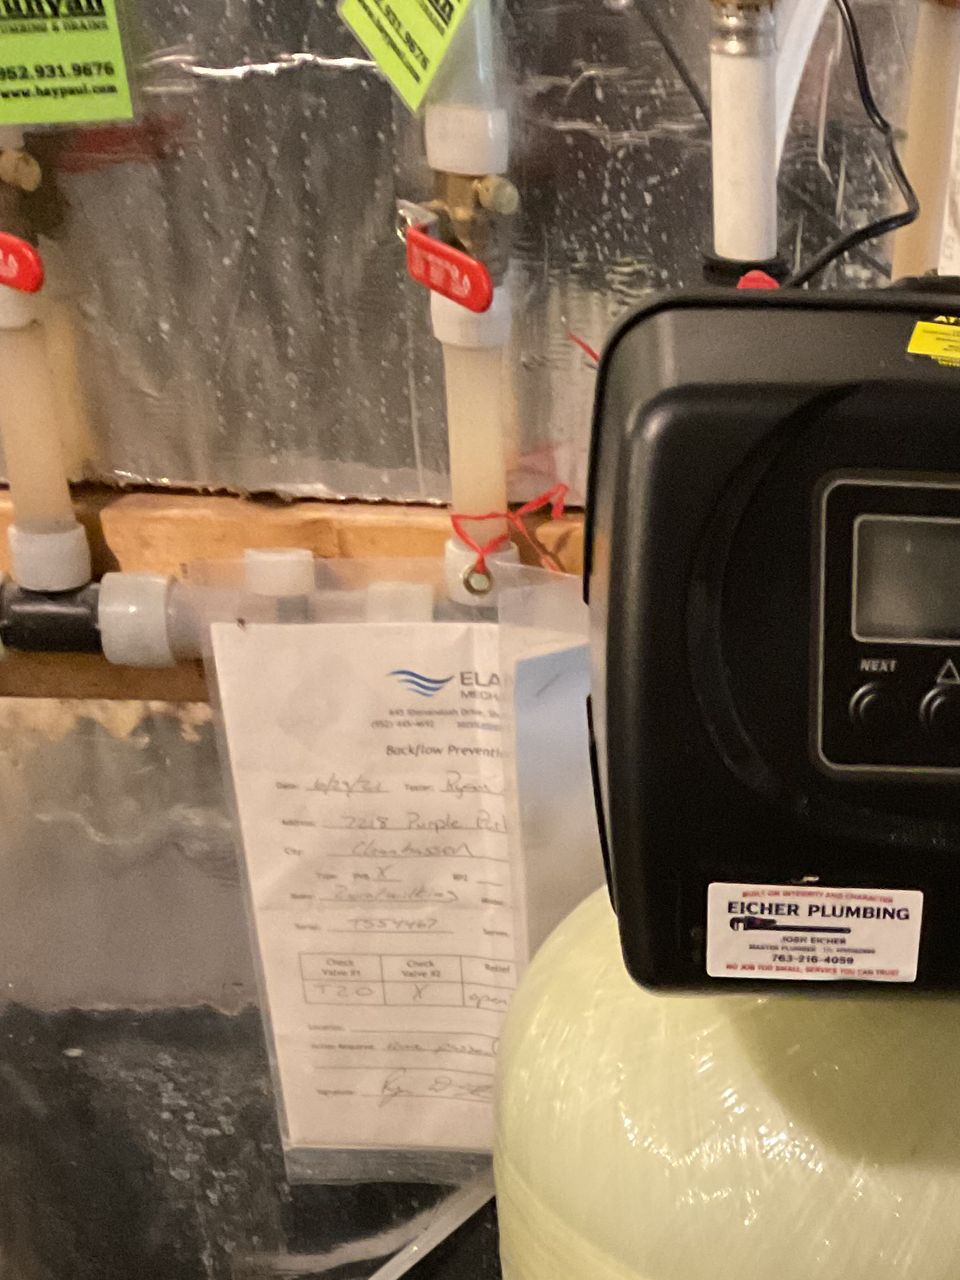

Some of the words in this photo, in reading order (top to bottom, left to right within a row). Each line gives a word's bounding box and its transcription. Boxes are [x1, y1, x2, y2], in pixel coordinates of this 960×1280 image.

[860, 659, 897, 673] NEXT
[386, 743, 443, 757] Backflow
[727, 901, 800, 917] EICHER
[807, 903, 910, 921] PLUMBING
[810, 937, 846, 945] EICHER
